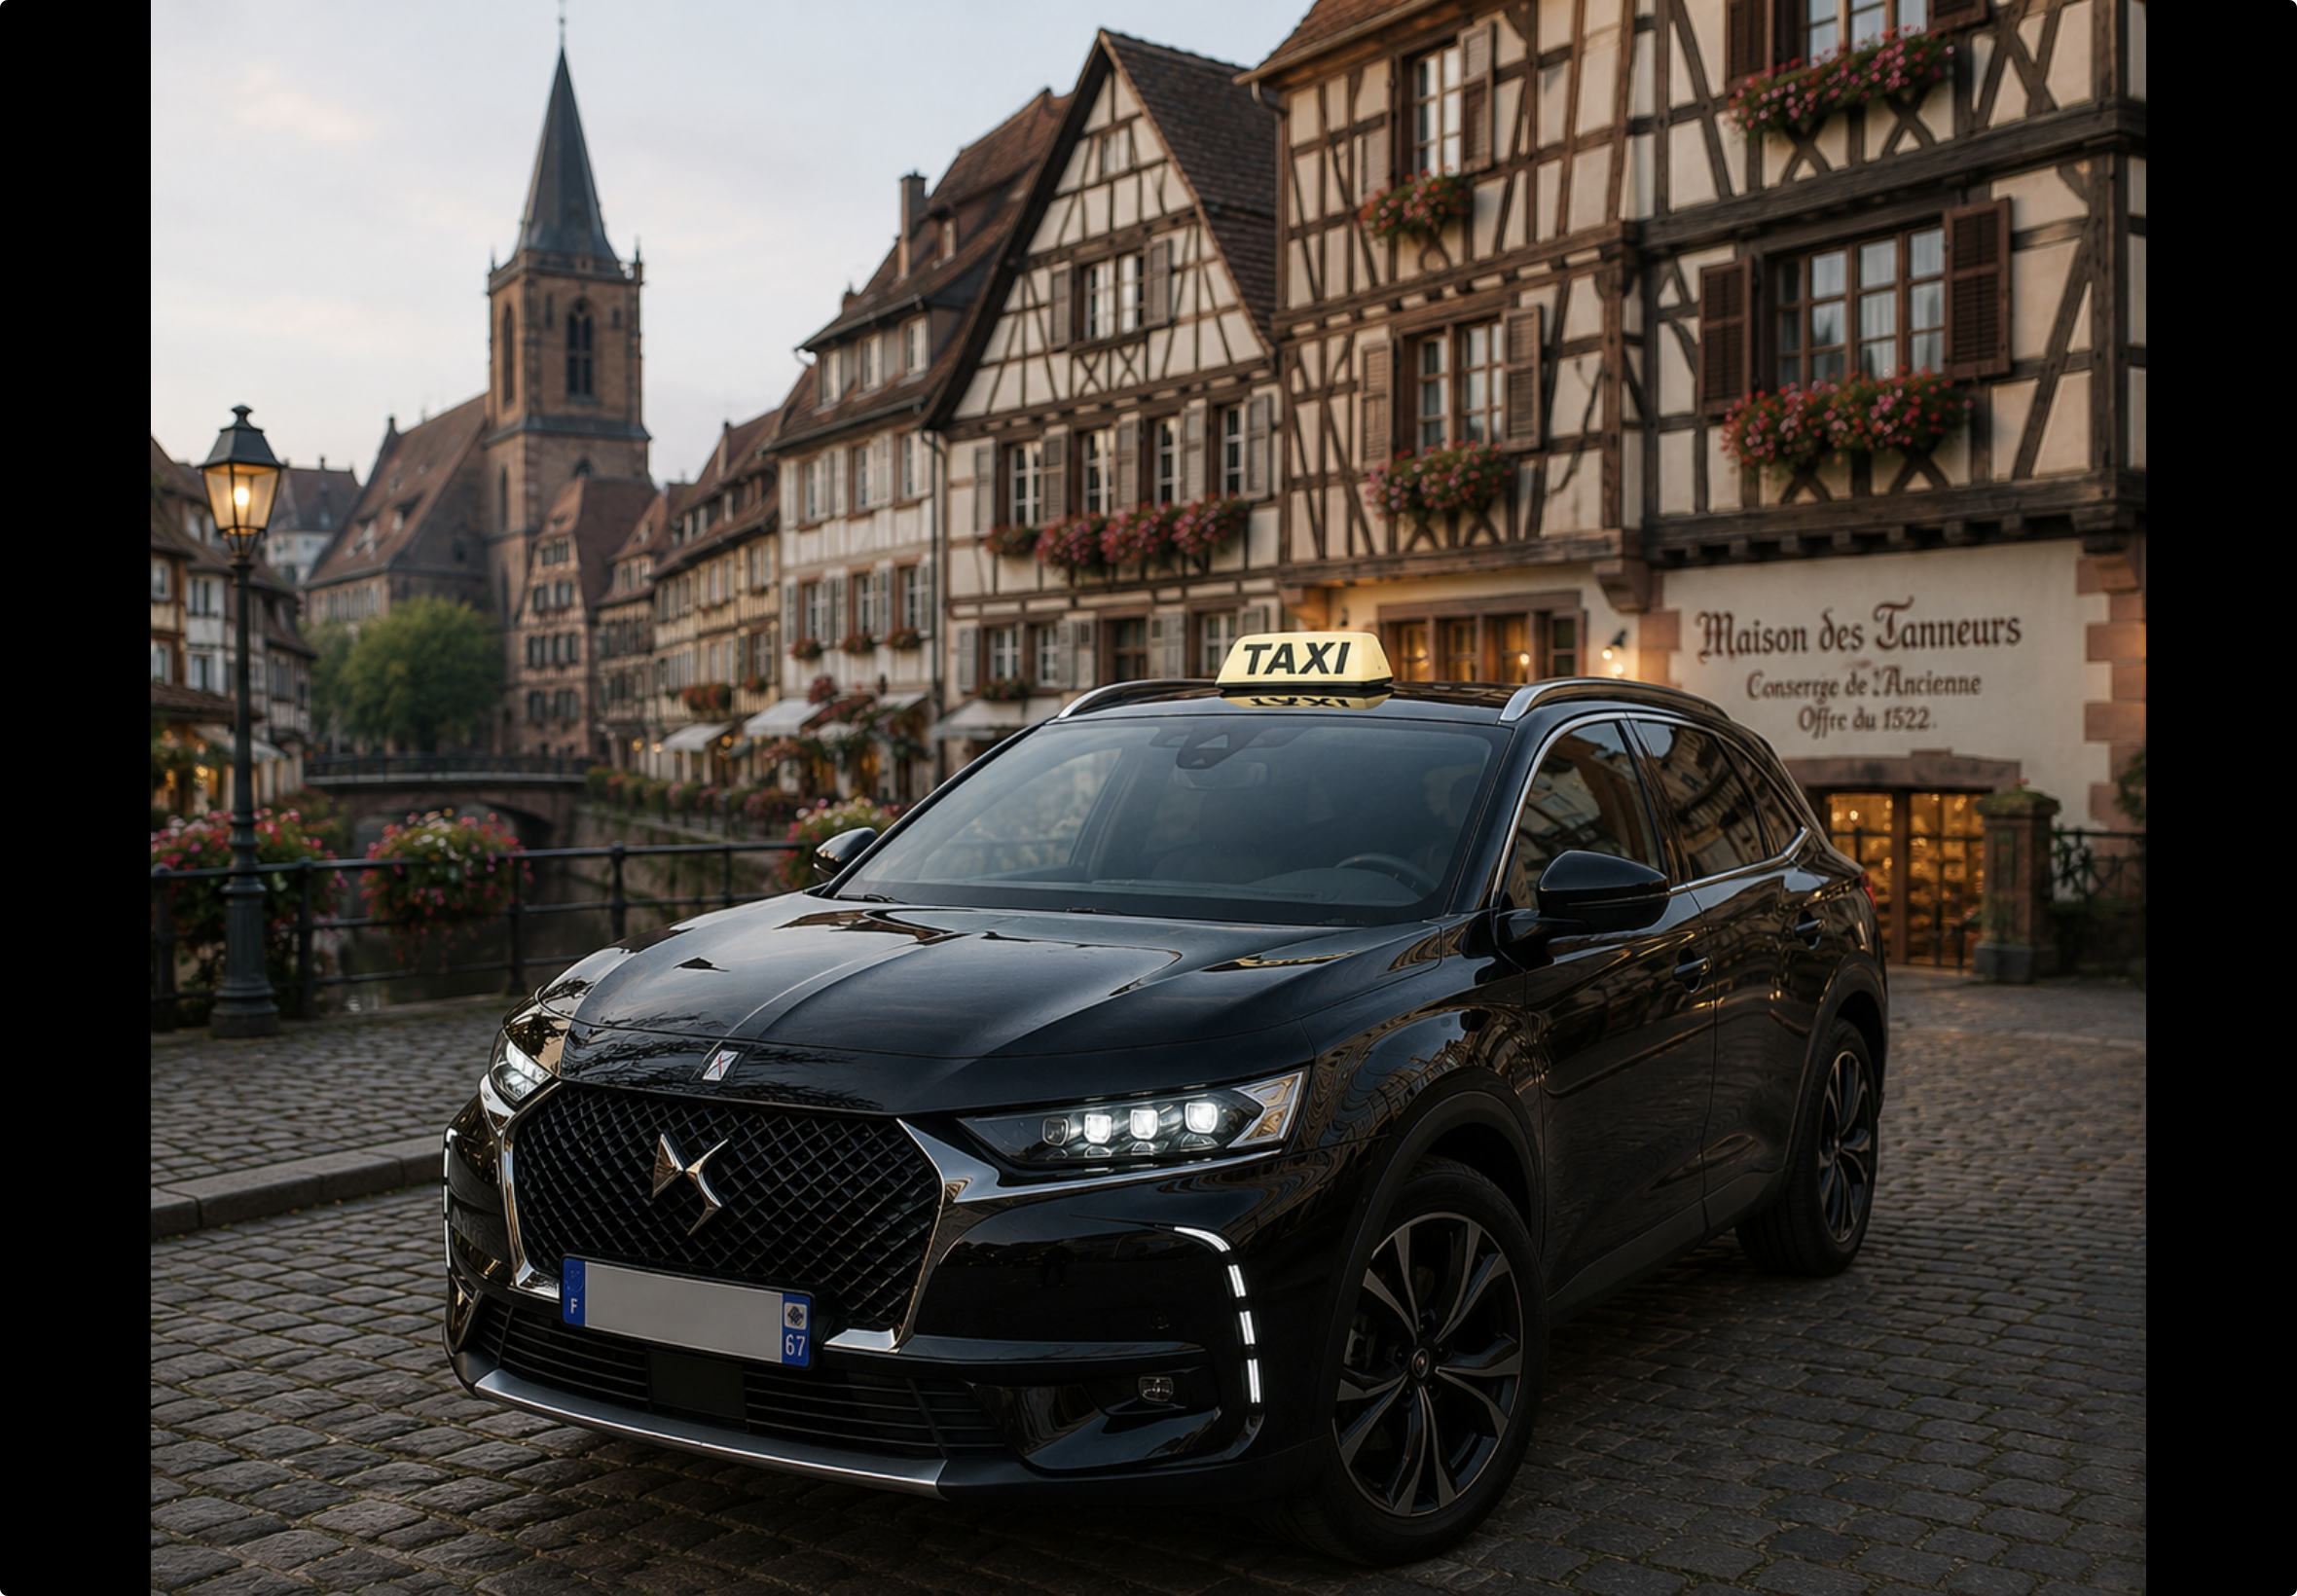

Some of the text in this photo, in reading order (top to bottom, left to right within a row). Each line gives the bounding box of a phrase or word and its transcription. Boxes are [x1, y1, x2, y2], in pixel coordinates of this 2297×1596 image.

[1695, 595, 2023, 665] Maison des Tanneurs
[1243, 641, 1351, 675] TAXI
[1844, 671, 1868, 698] de
[1853, 706, 1878, 730] du
[569, 1297, 578, 1314] F
[784, 1333, 807, 1358] 67
